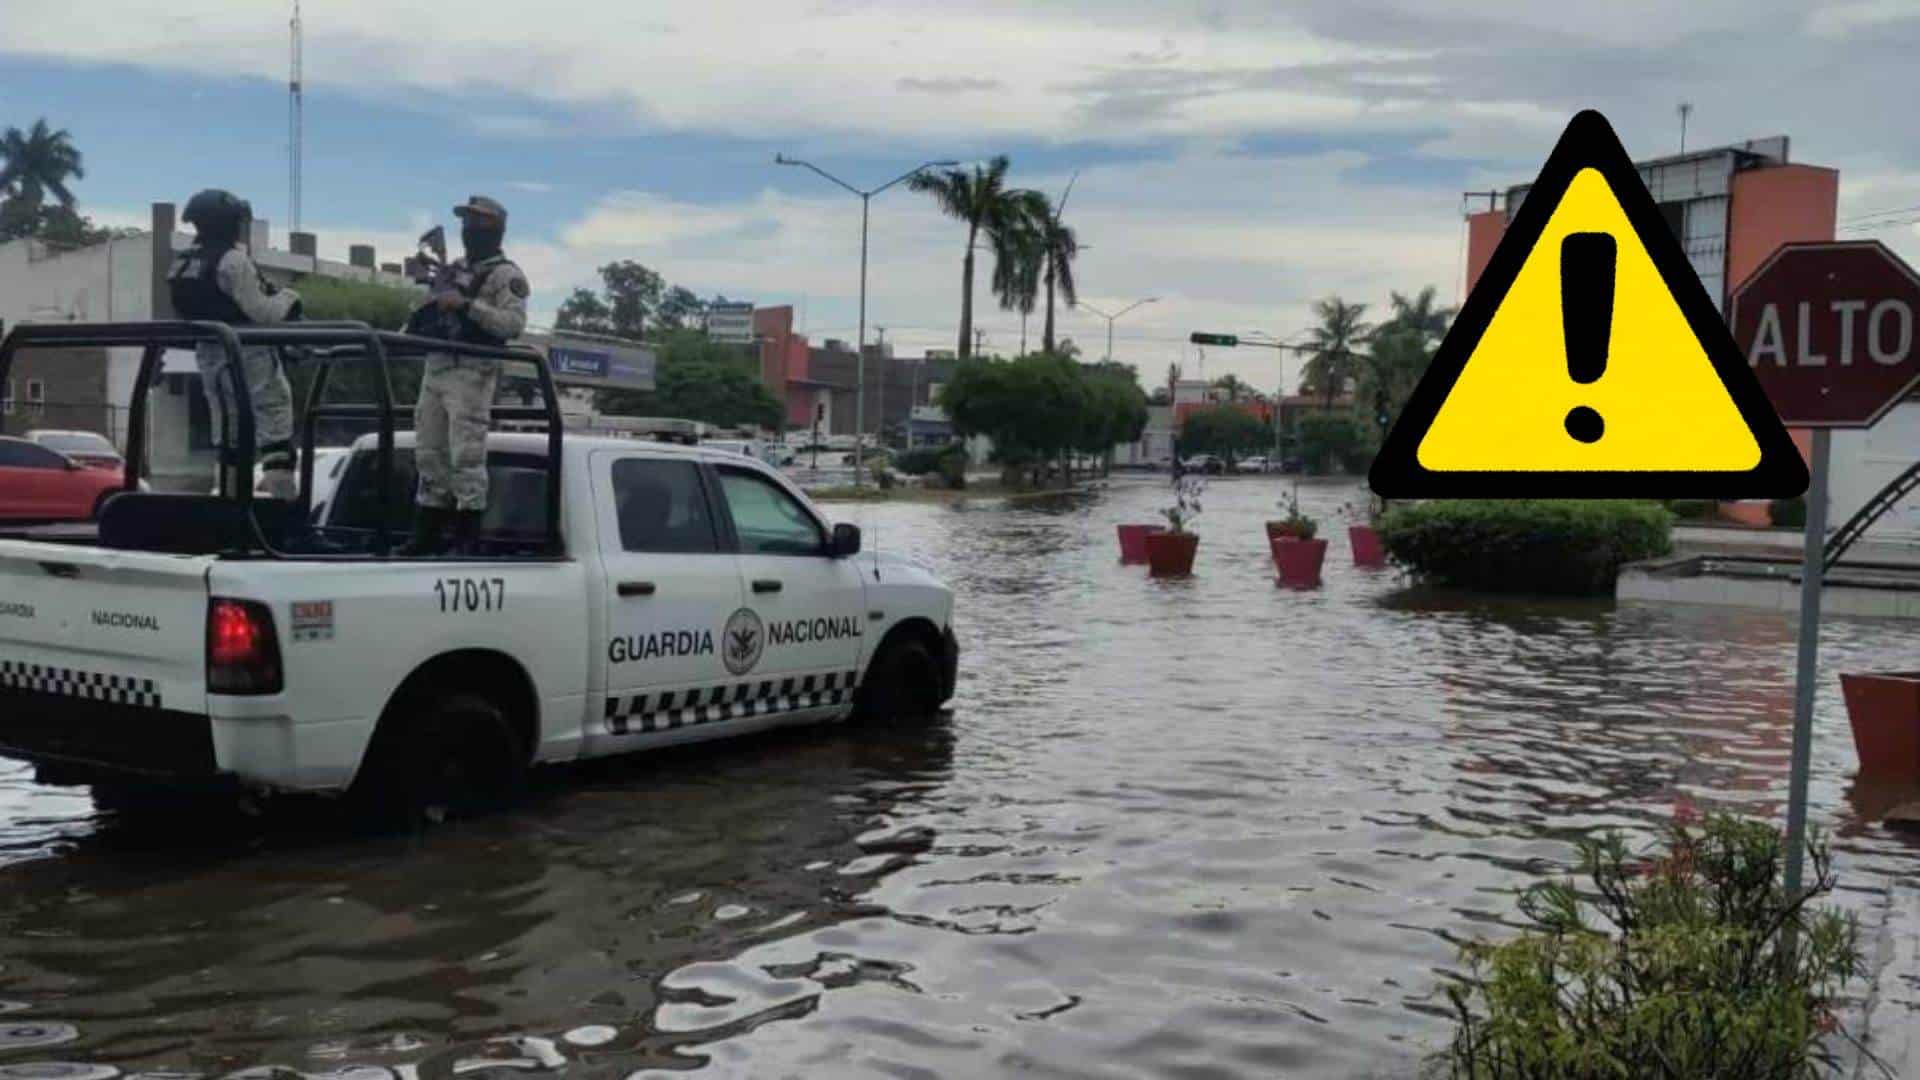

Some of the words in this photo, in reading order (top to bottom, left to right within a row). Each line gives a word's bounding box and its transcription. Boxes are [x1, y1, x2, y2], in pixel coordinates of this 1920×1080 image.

[1748, 298, 1913, 367] ALTO
[434, 578, 505, 613] 17017
[92, 609, 160, 631] NACIONAL
[608, 629, 714, 664] GUARDIA
[768, 615, 863, 646] NACIONAL
